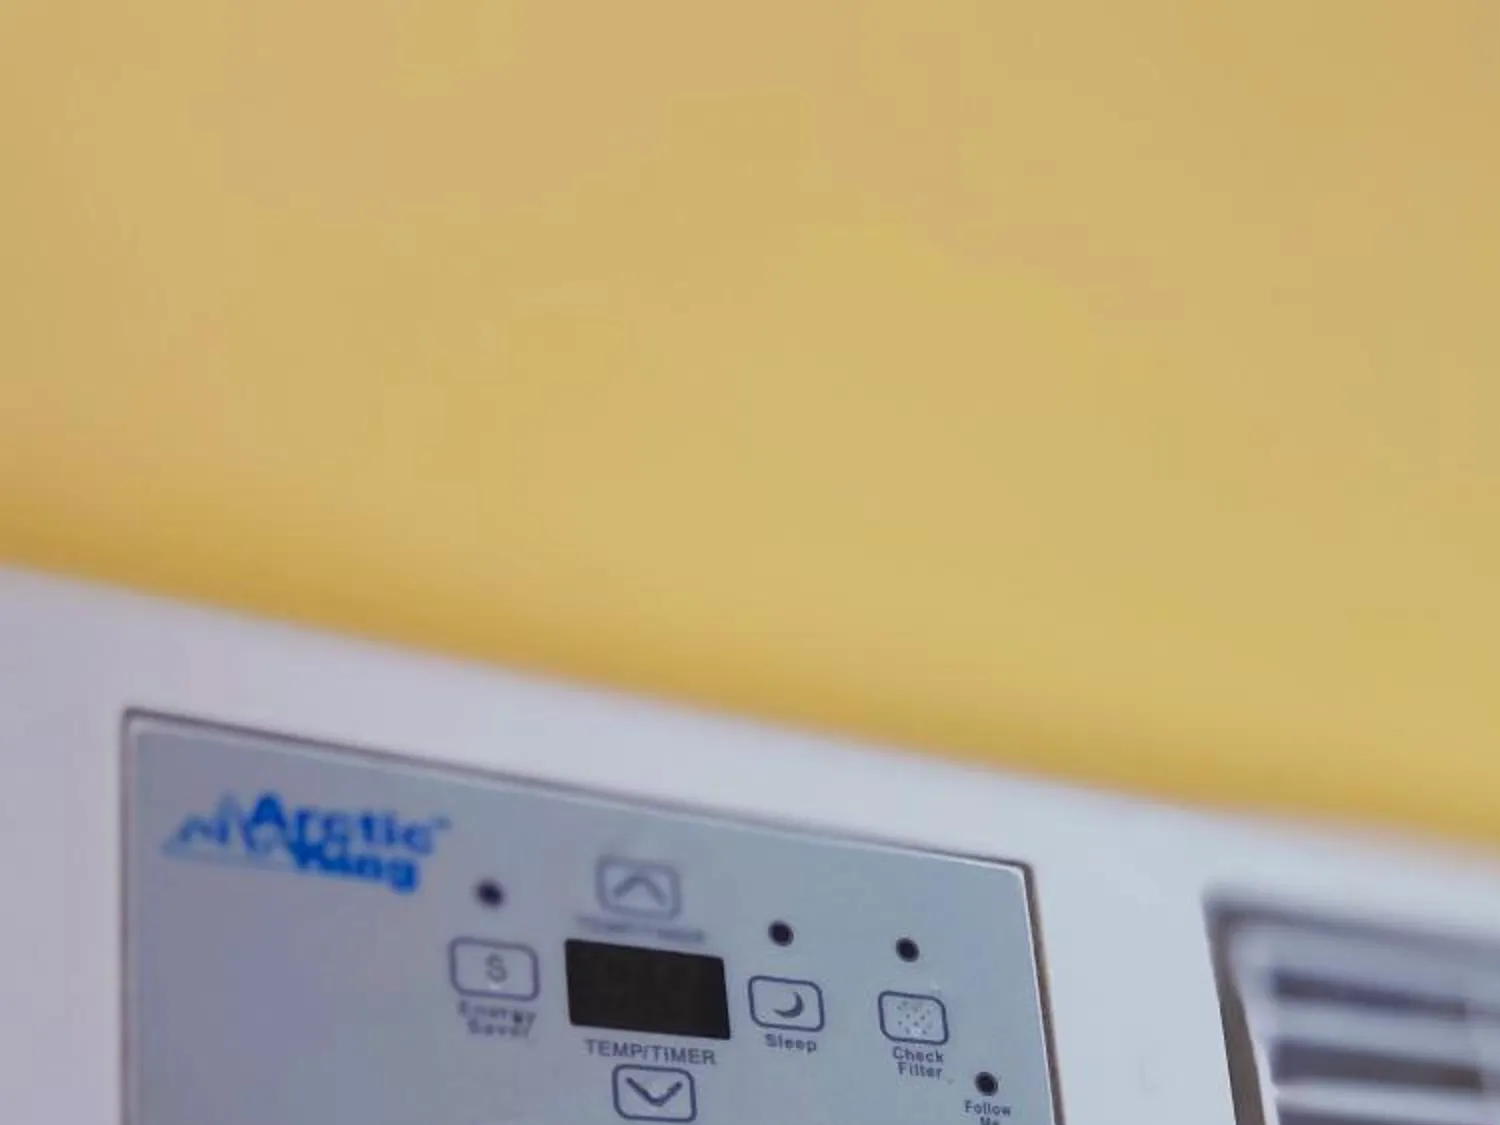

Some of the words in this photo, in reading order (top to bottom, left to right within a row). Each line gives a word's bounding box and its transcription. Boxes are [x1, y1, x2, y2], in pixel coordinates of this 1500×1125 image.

[251, 792, 436, 855] Arctic
[585, 1038, 717, 1066] TEMP/TIMER
[765, 1032, 818, 1053] Sleep
[892, 1046, 945, 1063] Check
[896, 1062, 942, 1080] Filter
[964, 1101, 1012, 1117] Follow
